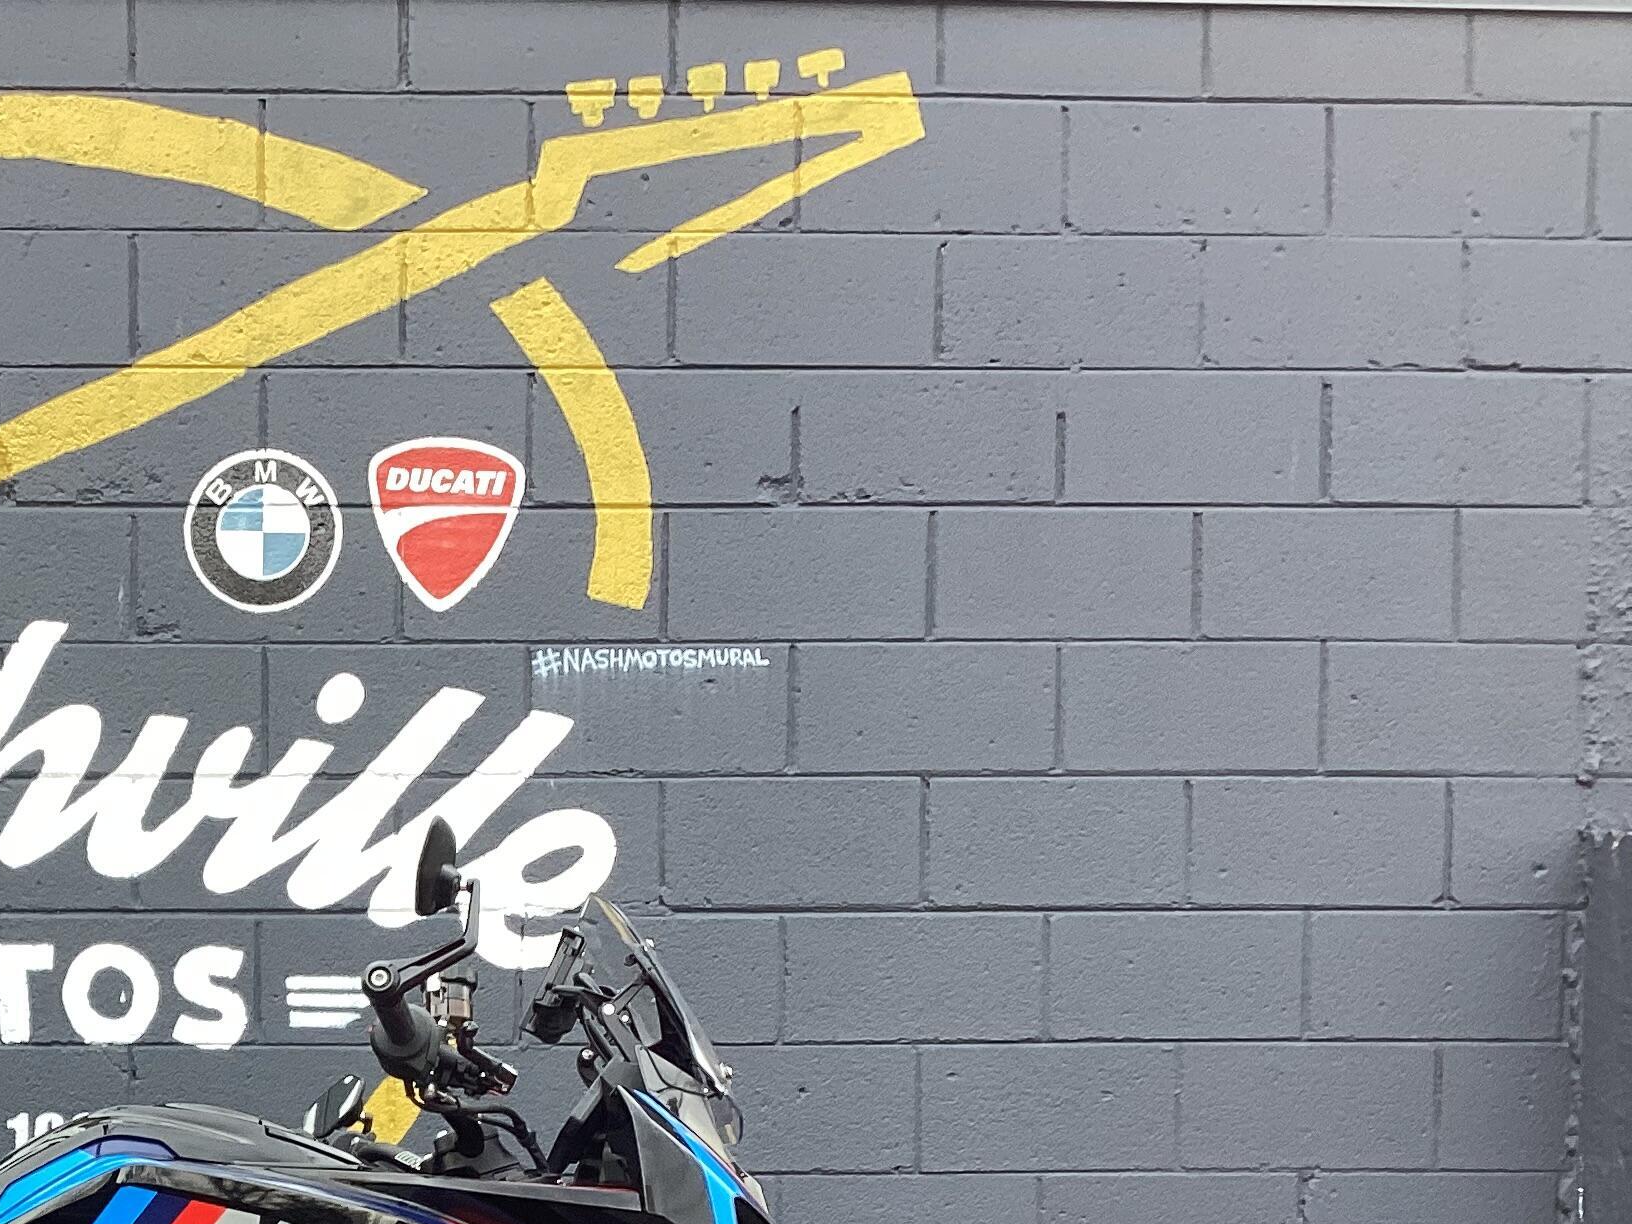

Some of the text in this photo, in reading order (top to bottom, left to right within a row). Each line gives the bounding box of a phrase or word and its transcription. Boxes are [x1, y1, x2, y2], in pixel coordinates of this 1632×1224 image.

[205, 460, 325, 506] BMW
[386, 467, 507, 496] DUCATI
[532, 647, 770, 678] #NASHMOTOSMURAL
